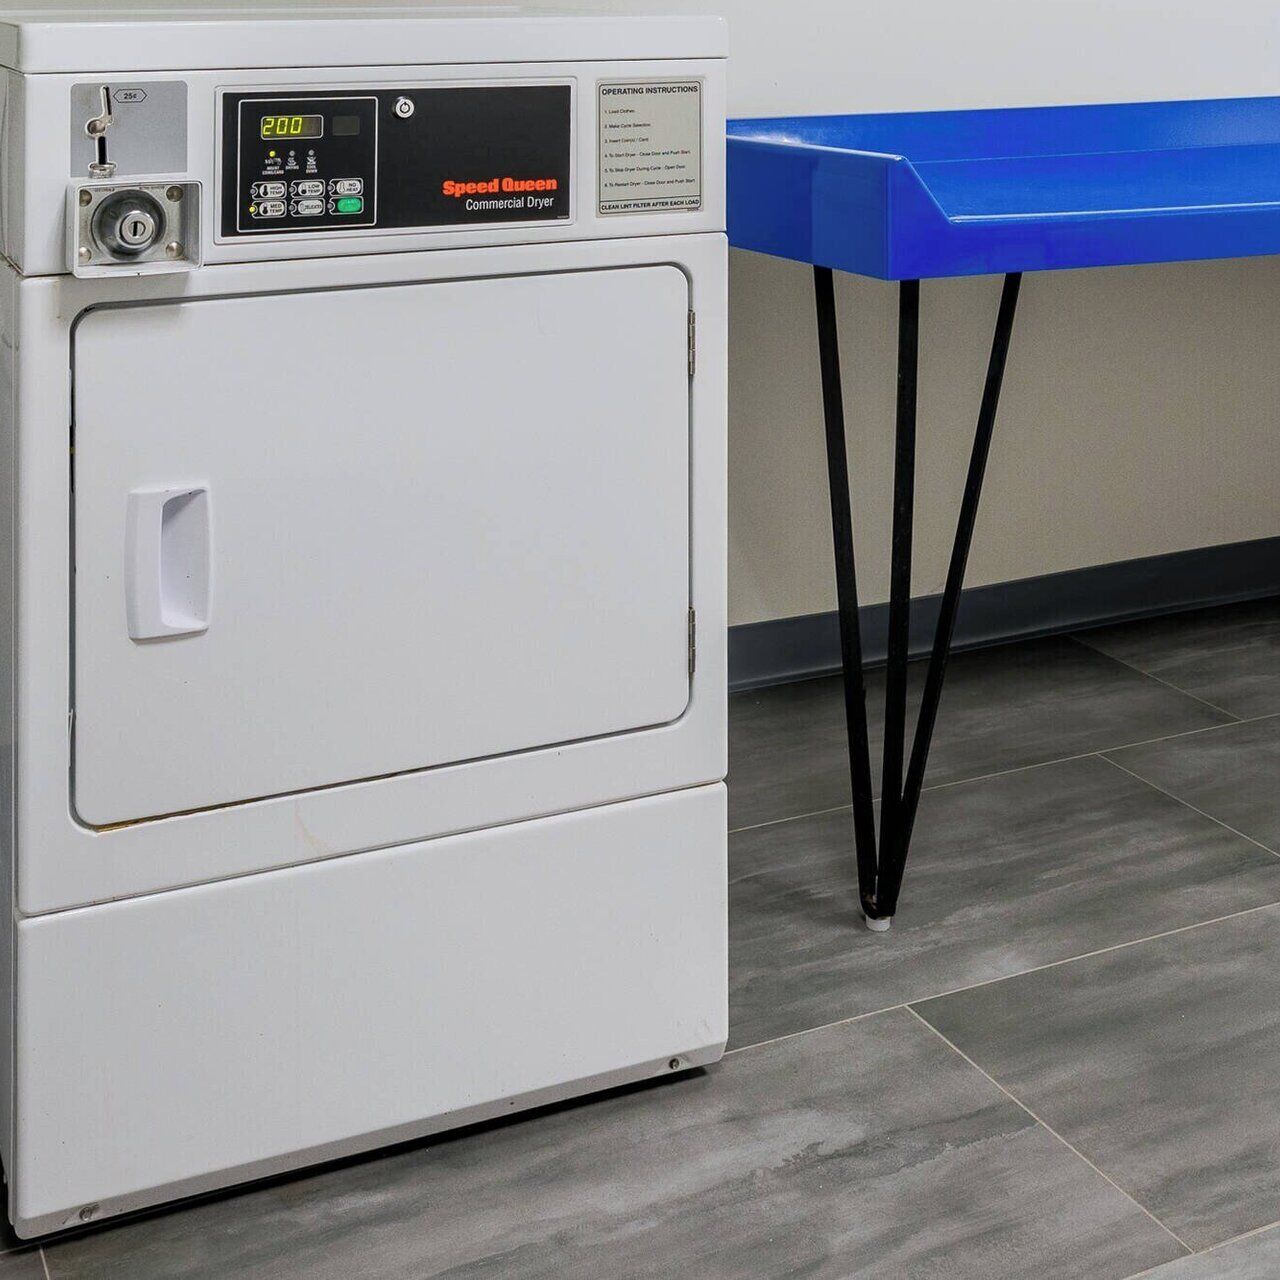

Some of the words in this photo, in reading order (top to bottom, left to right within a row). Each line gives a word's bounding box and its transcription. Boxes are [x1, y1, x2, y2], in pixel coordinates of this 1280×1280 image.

[646, 86, 698, 94] INSTRUCTIONS
[263, 118, 302, 134] 200
[443, 178, 499, 197] Speed
[502, 177, 557, 192] Queen
[466, 197, 524, 210] Commercial
[527, 196, 554, 209] Dryer
